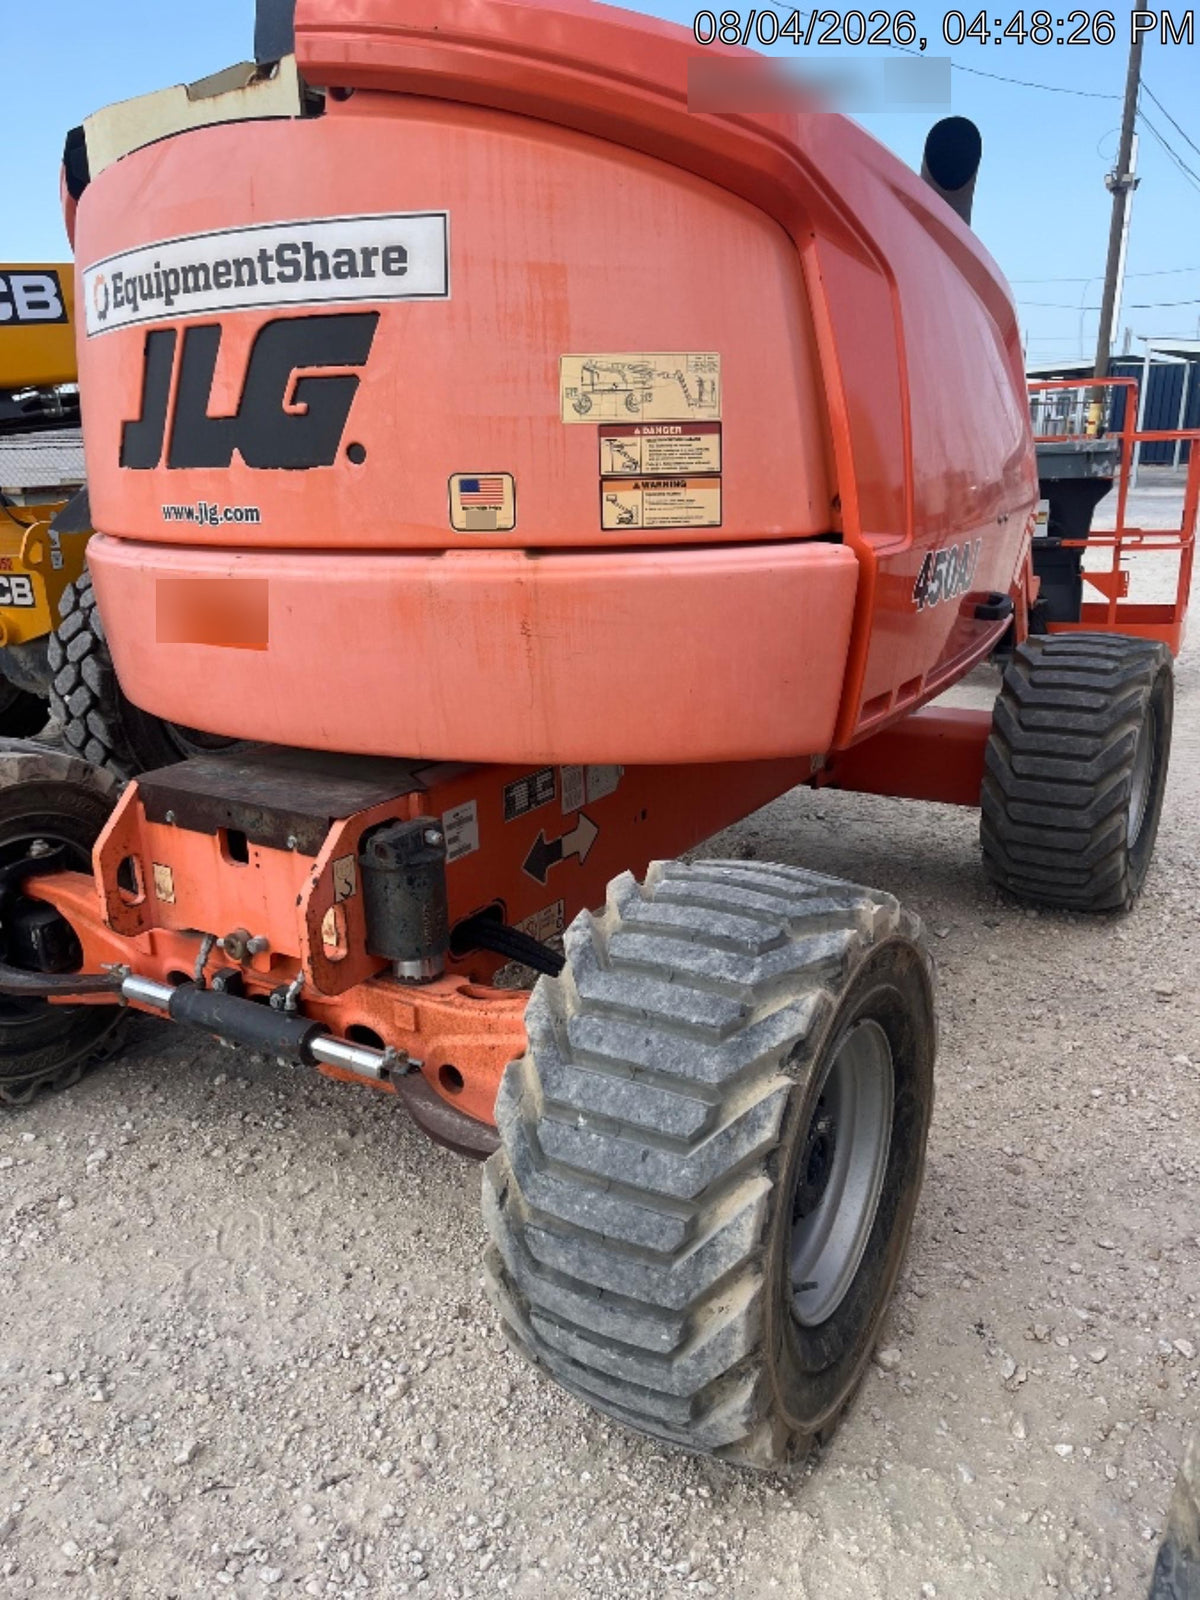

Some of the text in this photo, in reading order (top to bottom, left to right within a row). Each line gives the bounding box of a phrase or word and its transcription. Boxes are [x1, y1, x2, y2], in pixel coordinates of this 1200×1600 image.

[112, 241, 408, 311] EquipmentShare
[642, 426, 682, 434] DANGER
[641, 480, 687, 490] WARNING
[162, 502, 261, 526] www.jlg.com
